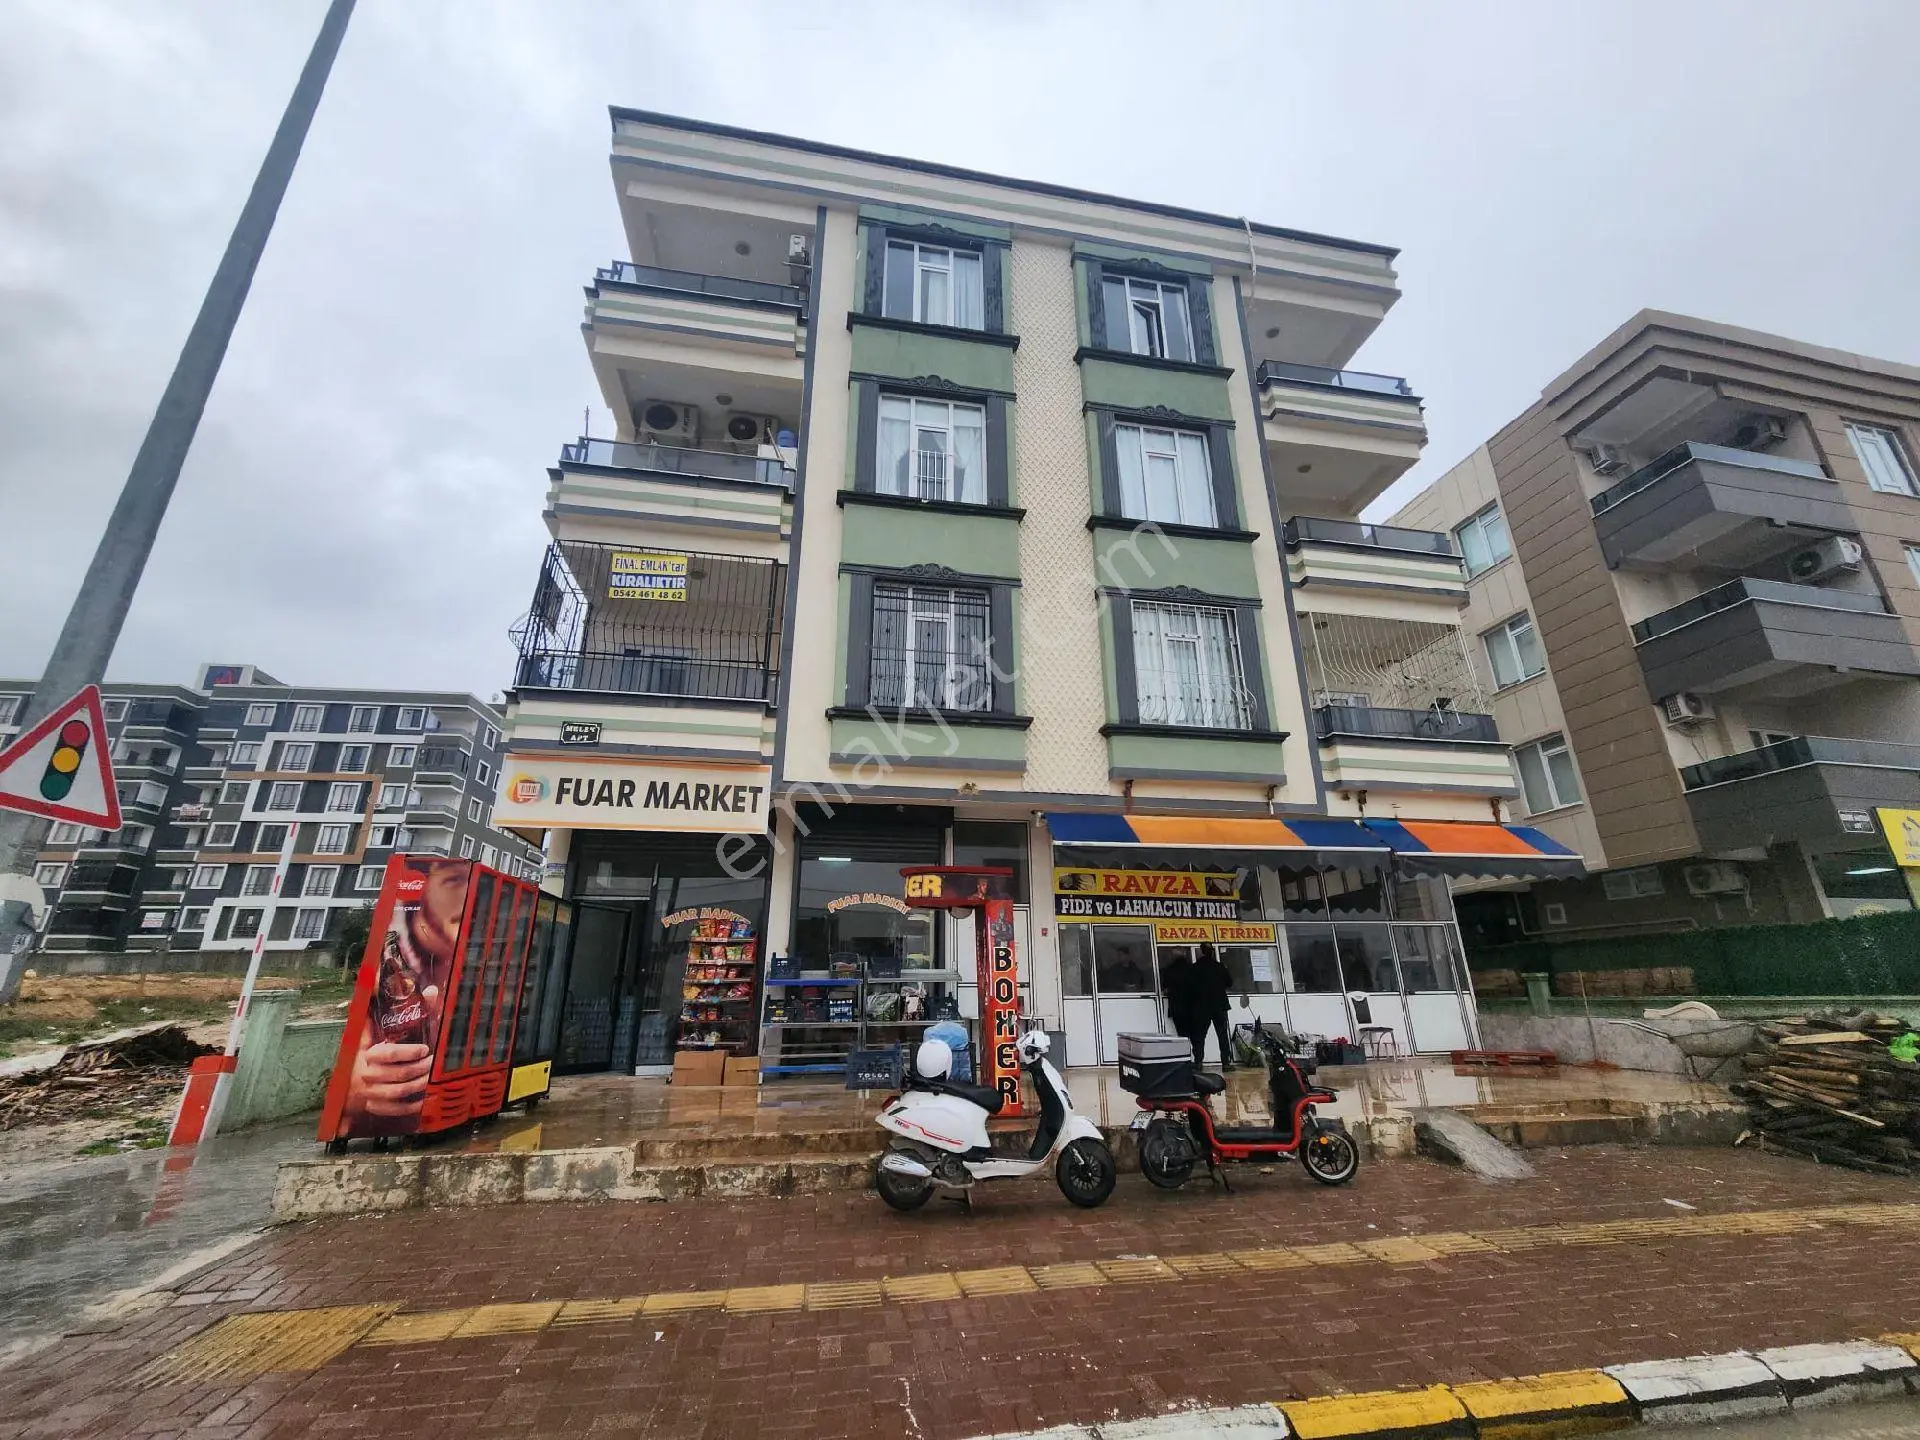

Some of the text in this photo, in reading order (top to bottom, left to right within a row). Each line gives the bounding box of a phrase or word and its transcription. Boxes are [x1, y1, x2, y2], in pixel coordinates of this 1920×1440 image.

[613, 589, 683, 600] 0542 461 48 62
[555, 777, 764, 814] FUAR MARKET
[905, 874, 942, 898] ER
[1103, 873, 1200, 895] RAVZA
[826, 892, 912, 915] FUAR MARKET
[1060, 894, 1237, 919] PİDE ve LAHMACUN FIRINI
[661, 907, 699, 929] FUAR
[1159, 926, 1270, 940] RAVZA FIRINI
[994, 947, 1019, 1104] BOXER
